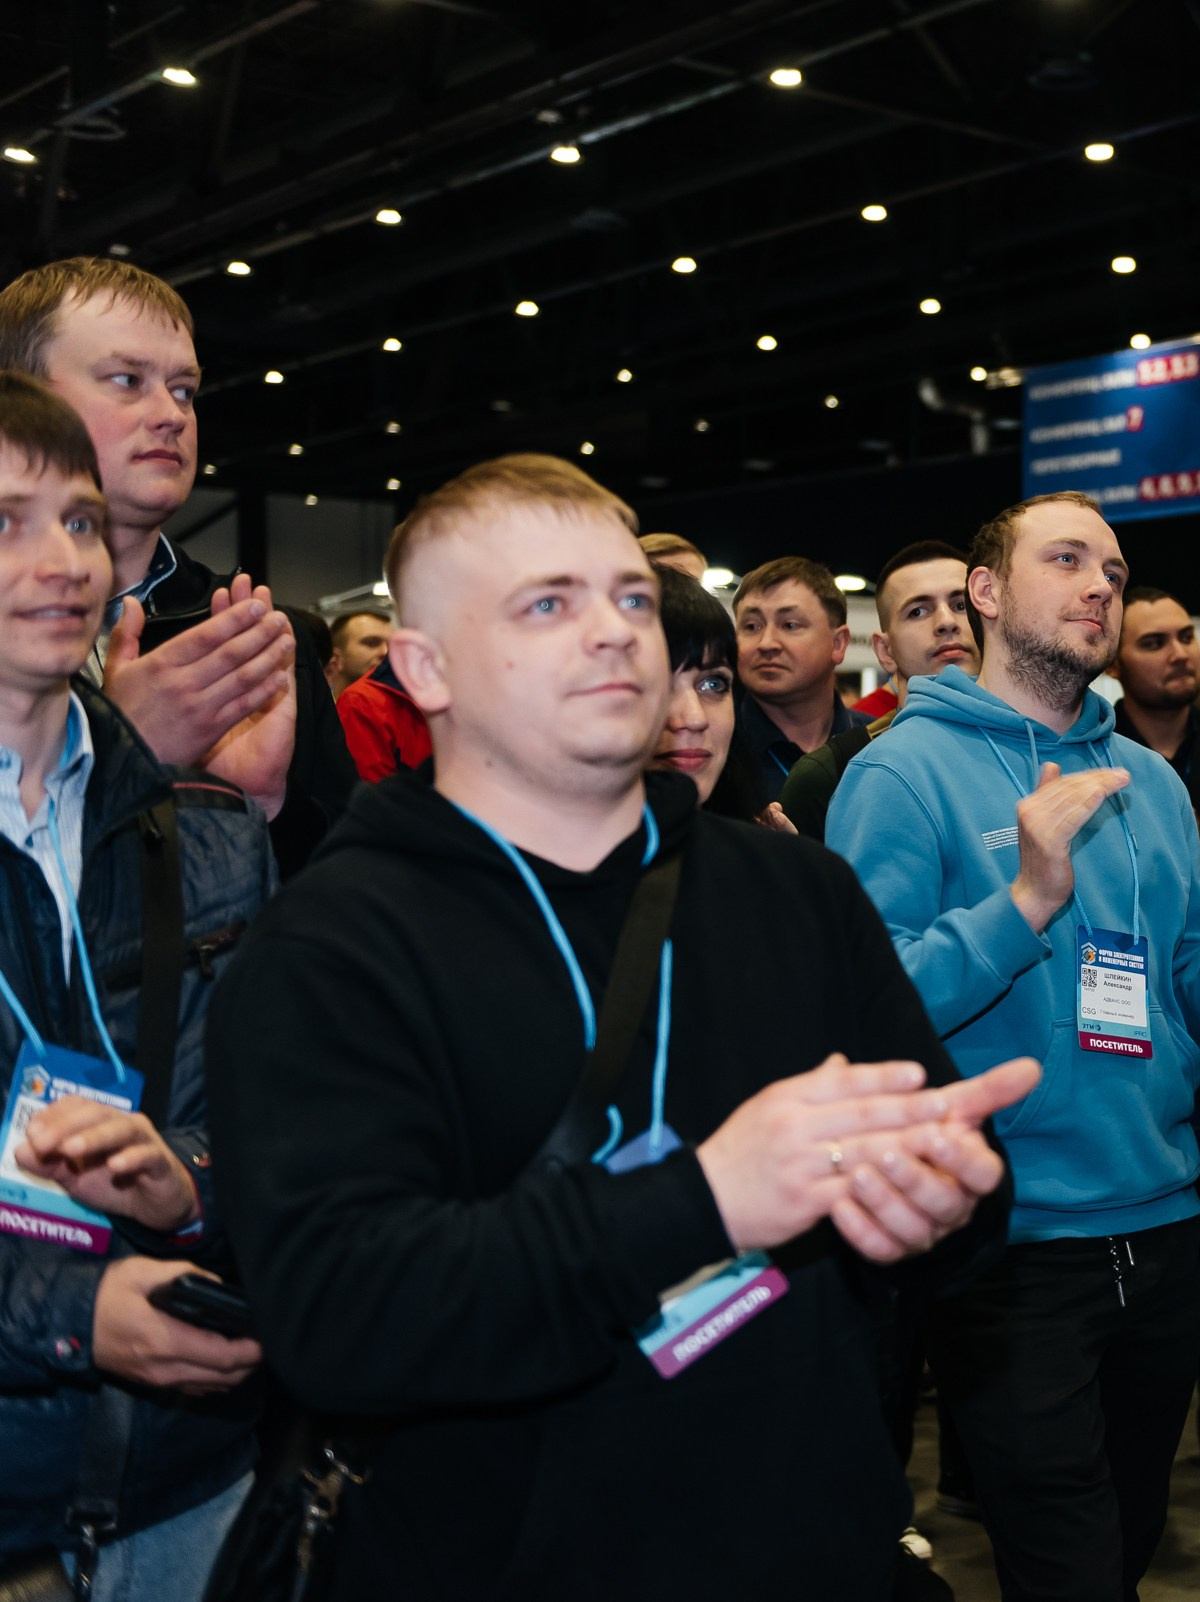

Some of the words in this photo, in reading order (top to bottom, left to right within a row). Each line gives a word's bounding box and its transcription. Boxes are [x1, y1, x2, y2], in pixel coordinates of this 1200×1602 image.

[1104, 972, 1132, 983] ШЛЕЙКИН
[1103, 981, 1133, 991] Александр
[1082, 1007, 1097, 1015] CSG
[1089, 1038, 1143, 1054] ПОСЕТИТЕЛЬ
